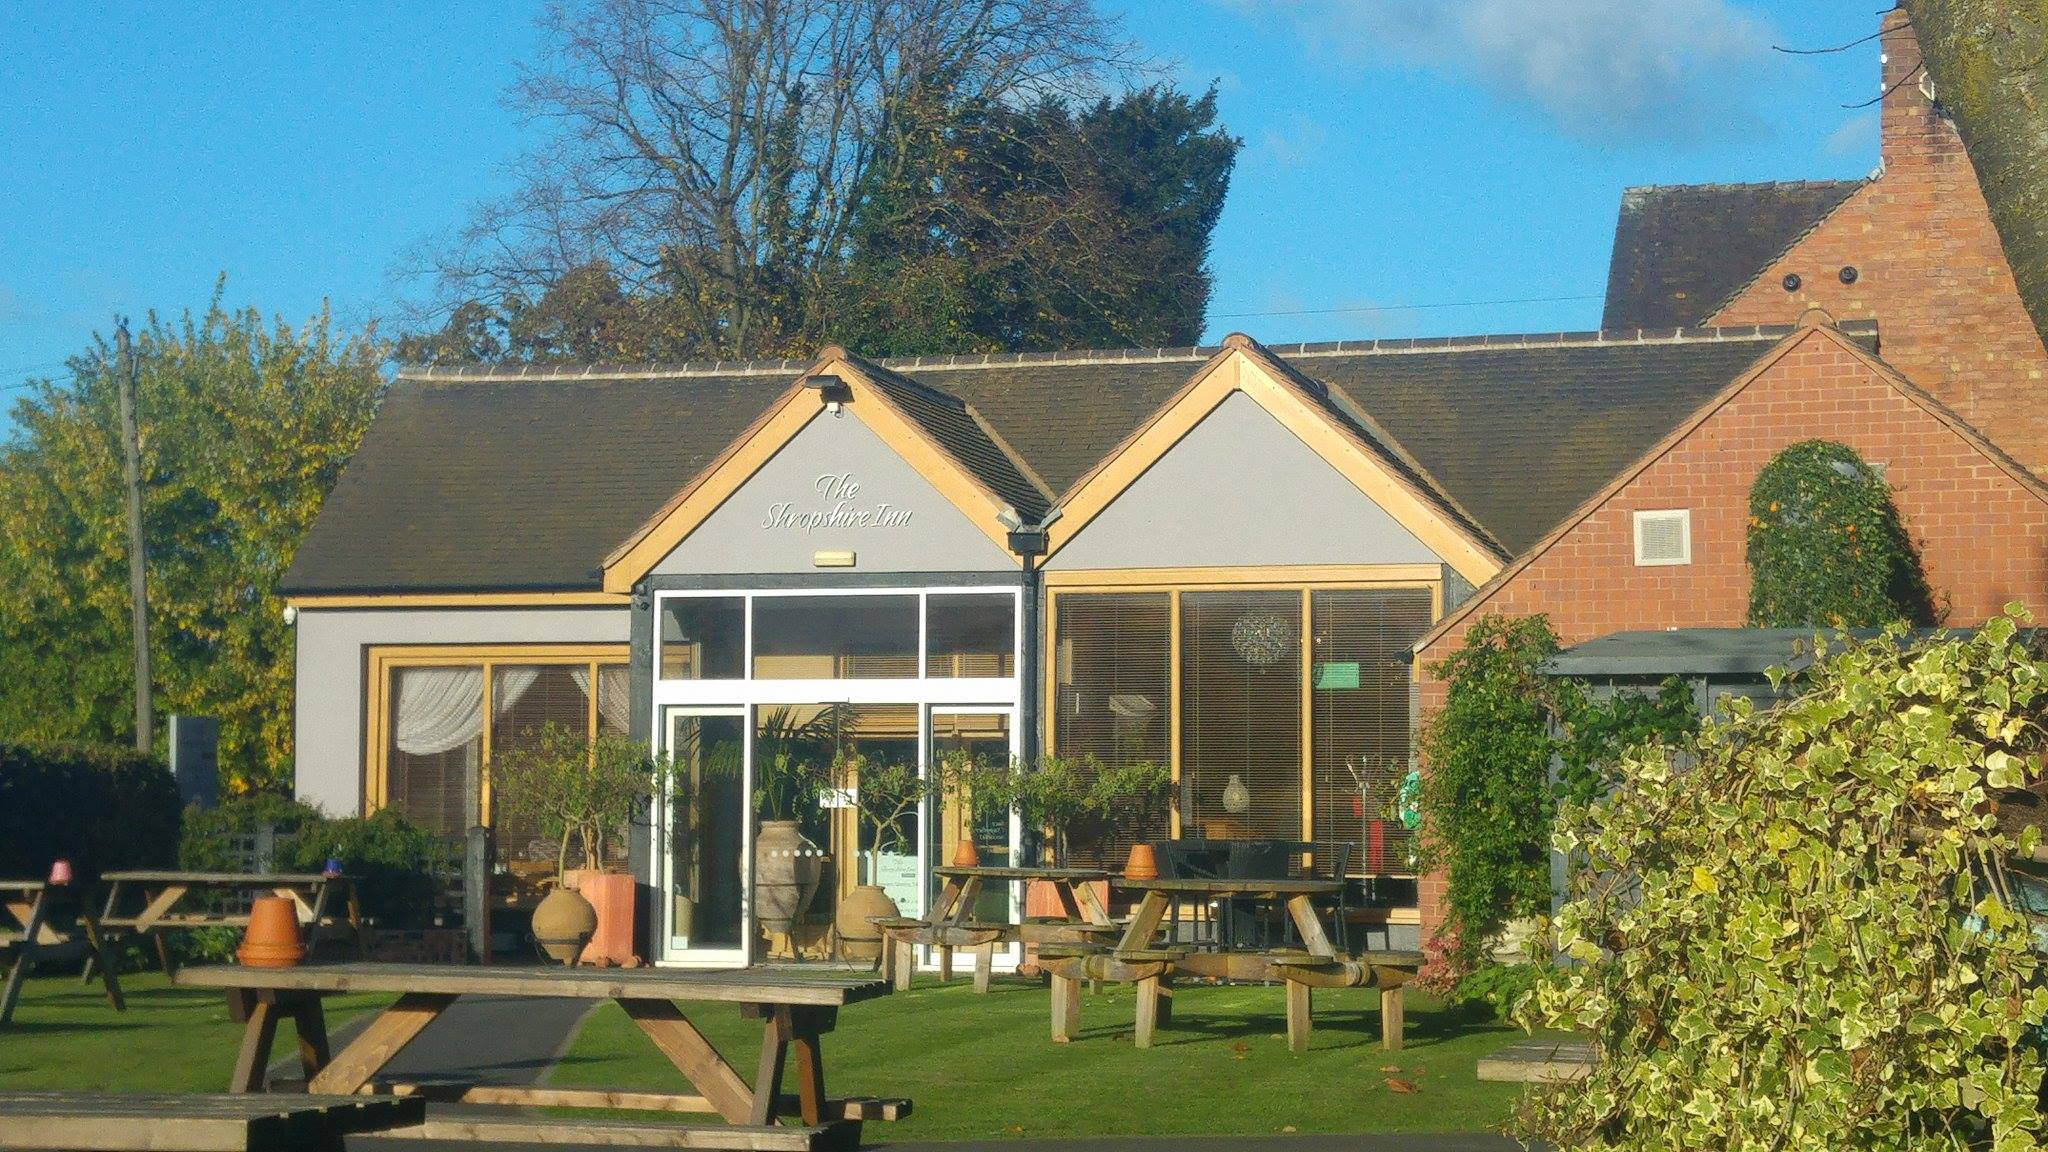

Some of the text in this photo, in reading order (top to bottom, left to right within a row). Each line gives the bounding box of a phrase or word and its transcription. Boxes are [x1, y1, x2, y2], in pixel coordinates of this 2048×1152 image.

[814, 472, 861, 501] The
[762, 501, 914, 534] Shropshire Inn
